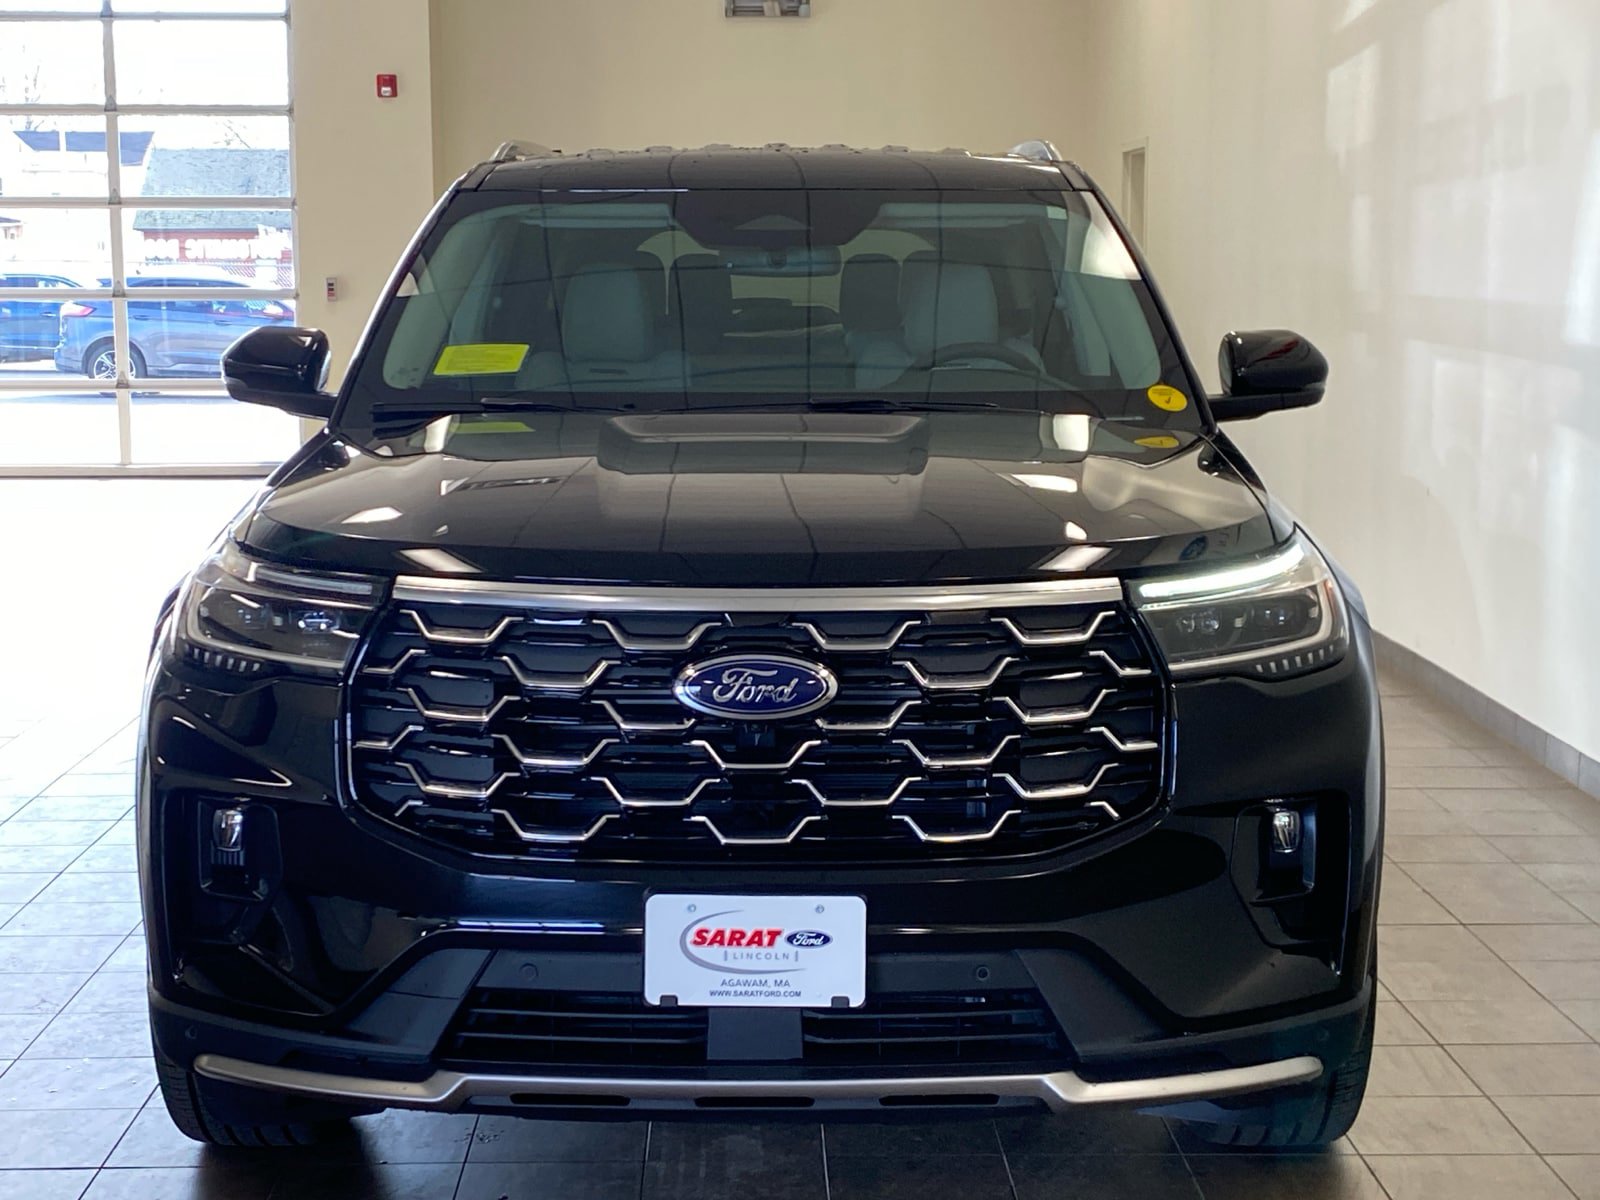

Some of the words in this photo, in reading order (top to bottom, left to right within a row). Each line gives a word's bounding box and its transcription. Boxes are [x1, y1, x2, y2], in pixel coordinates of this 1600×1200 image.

[712, 667, 799, 703] Ford
[691, 928, 782, 947] SARAT
[793, 933, 823, 947] Ford
[720, 979, 770, 988] AGAWAM,
[774, 979, 790, 988] MA
